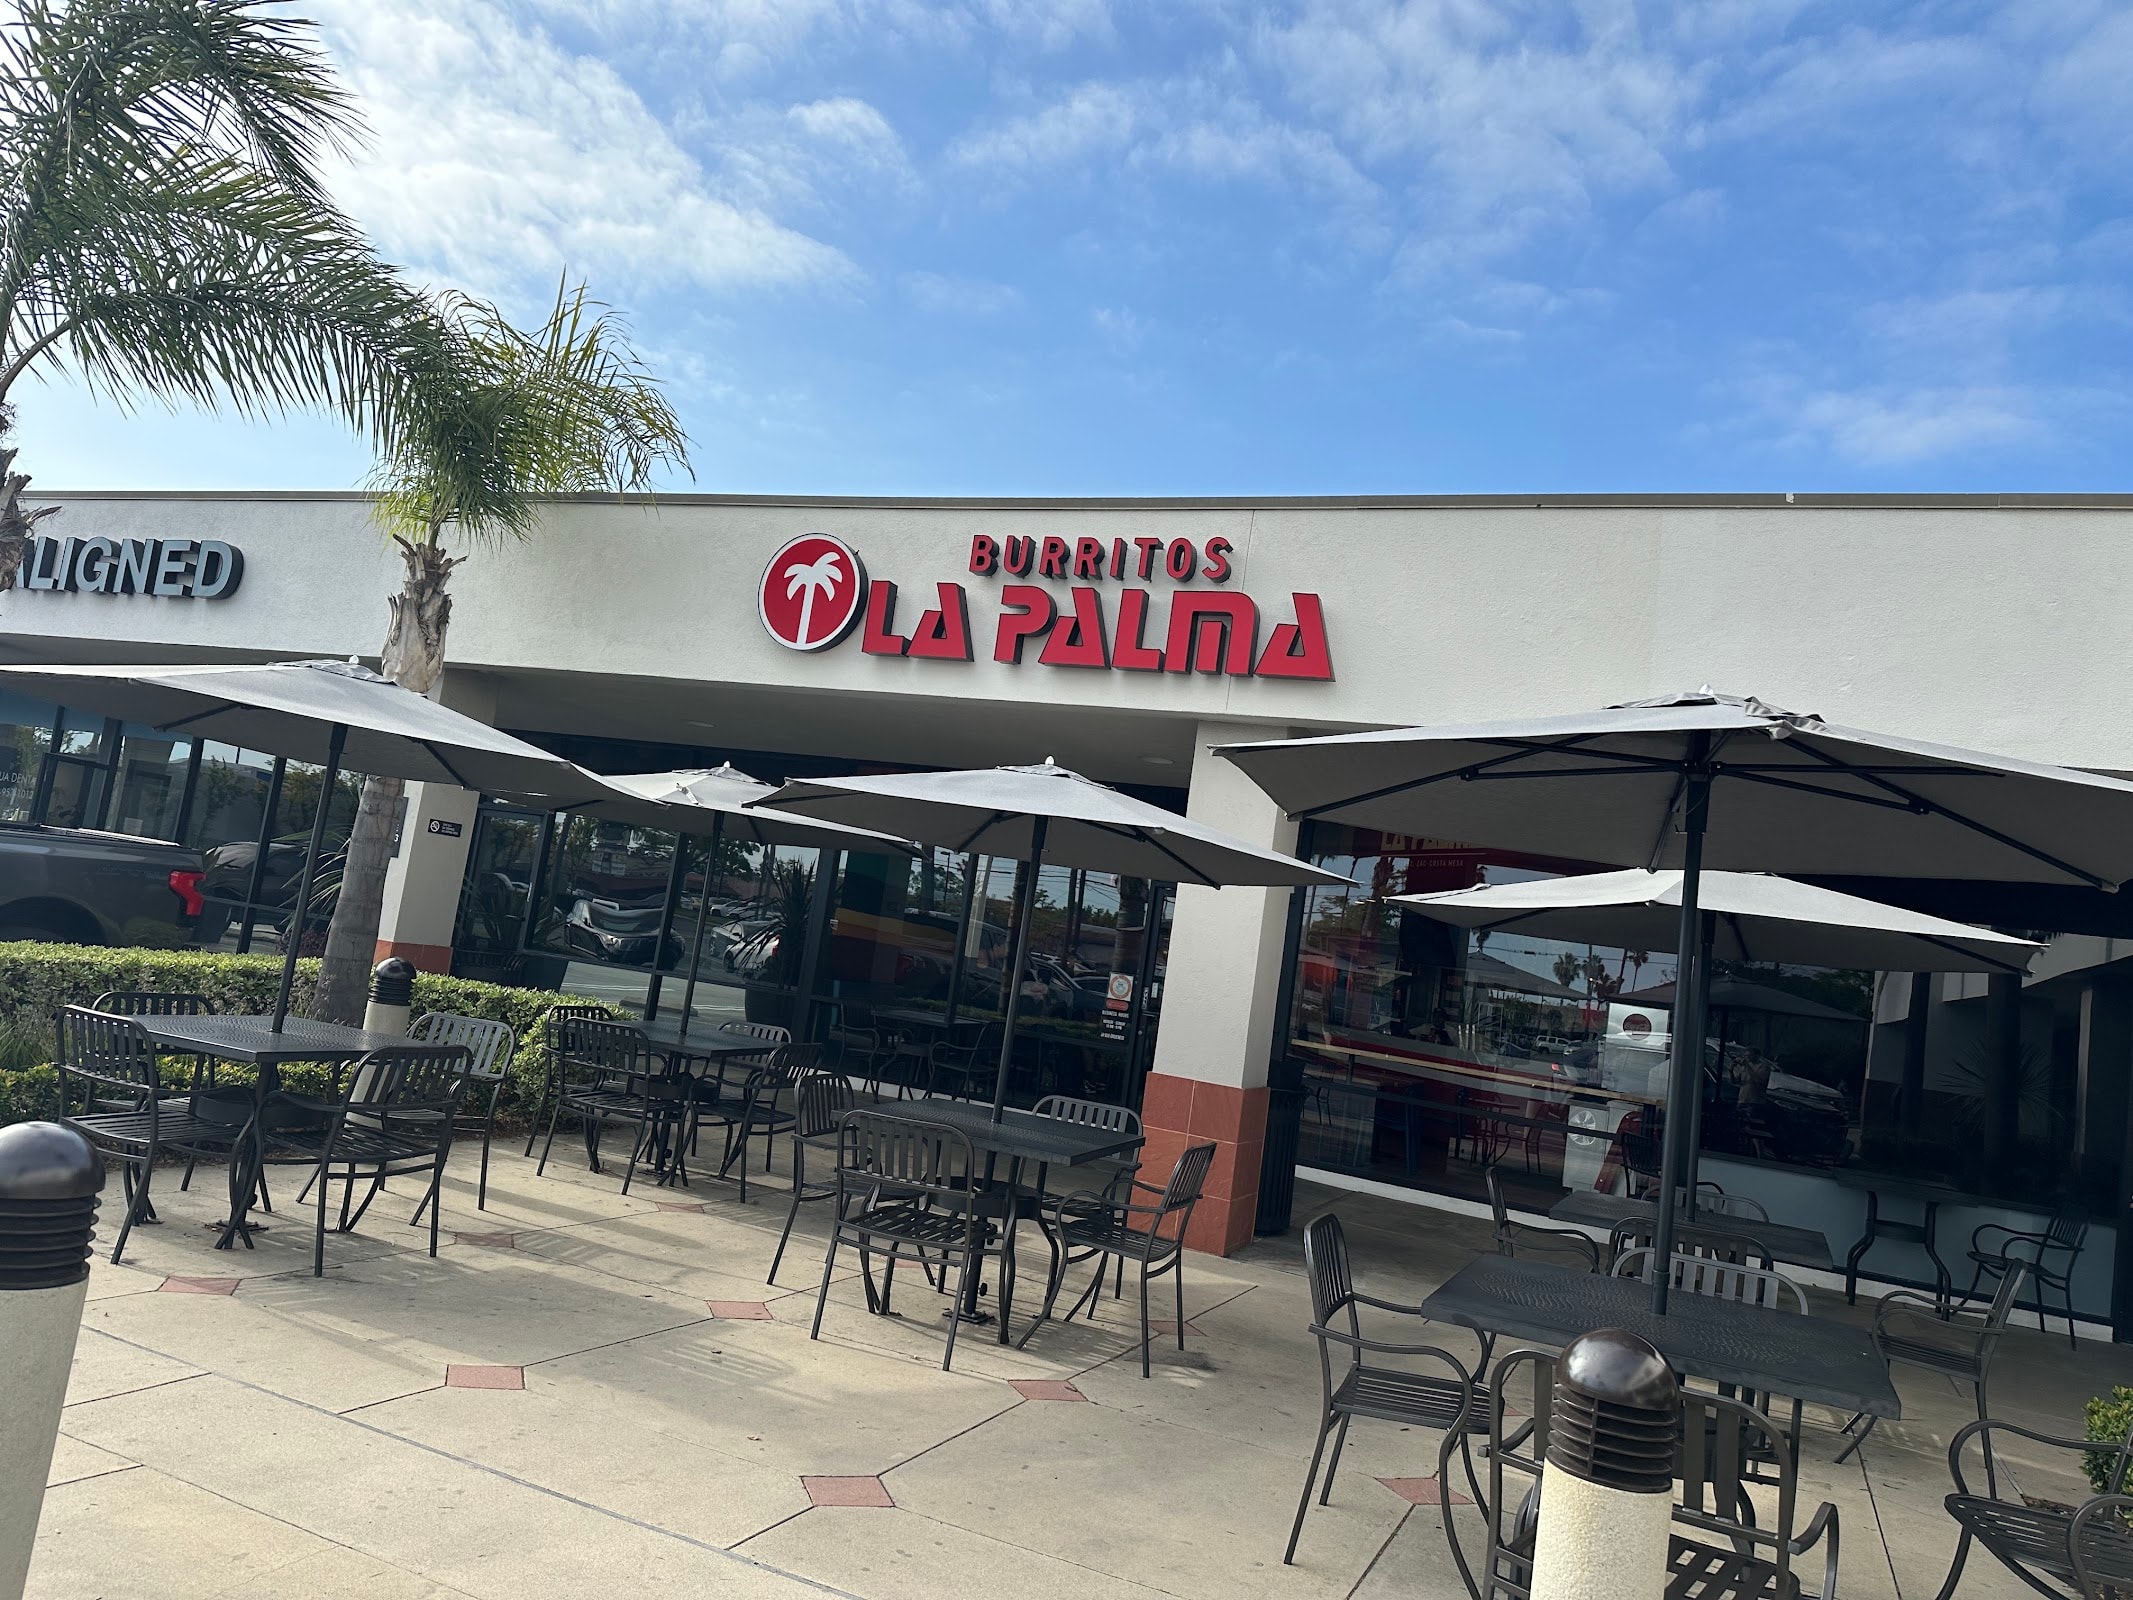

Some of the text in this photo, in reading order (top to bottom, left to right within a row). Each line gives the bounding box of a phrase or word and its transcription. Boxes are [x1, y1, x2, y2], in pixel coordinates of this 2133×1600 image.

[968, 534, 1235, 582] BURRITOS
[861, 579, 1336, 682] LA PALMA
